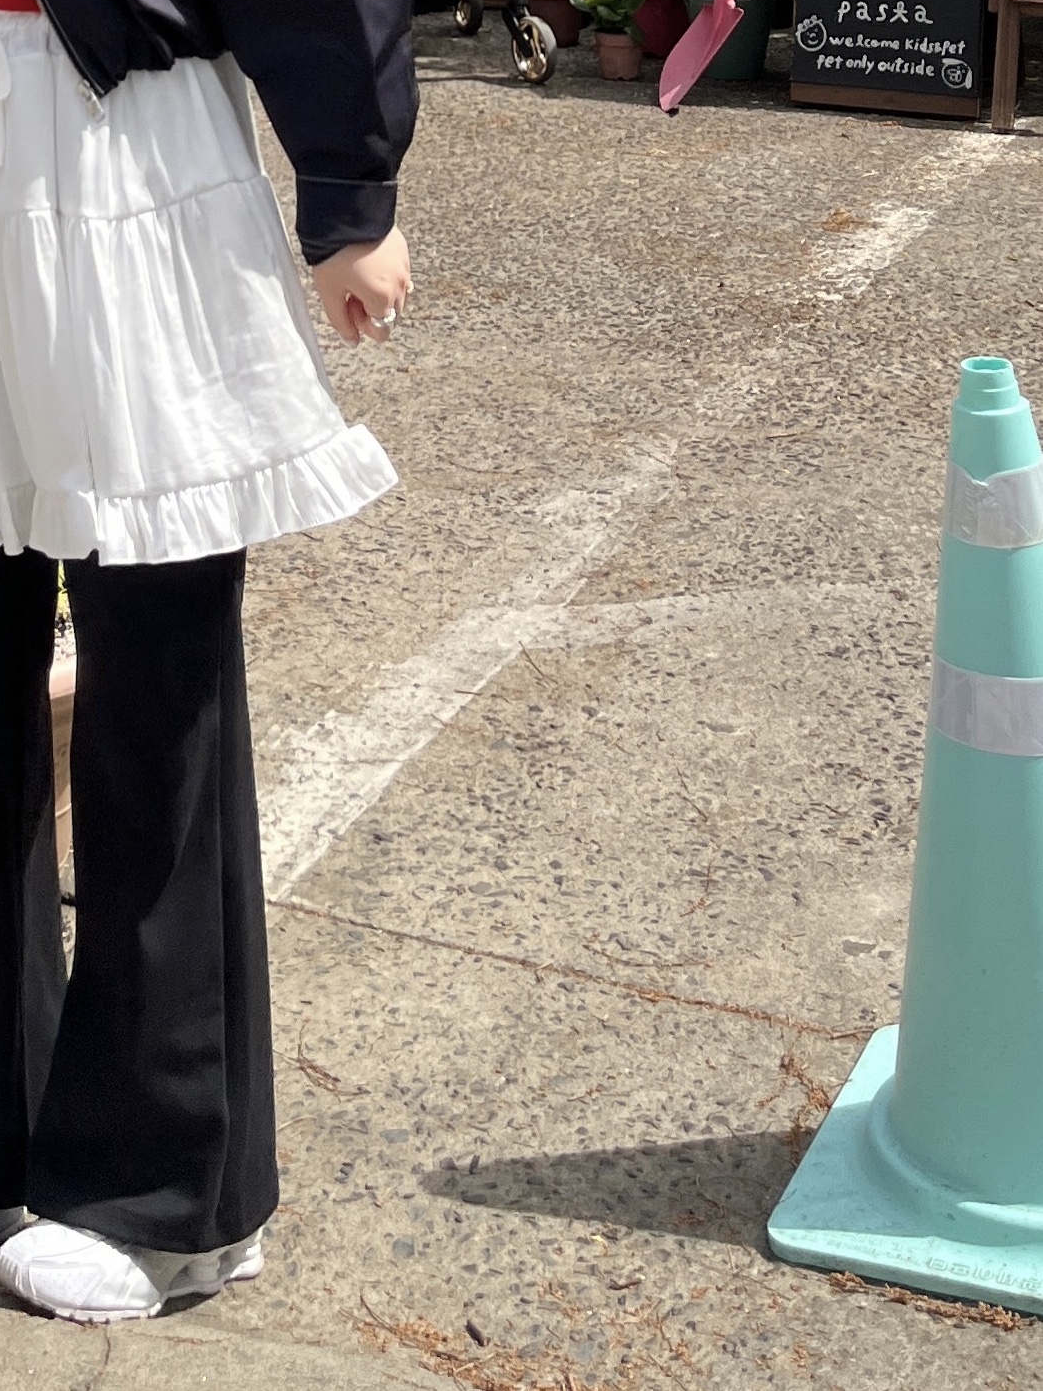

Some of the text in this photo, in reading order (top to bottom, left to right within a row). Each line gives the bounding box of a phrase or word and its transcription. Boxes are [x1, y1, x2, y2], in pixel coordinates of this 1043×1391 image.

[837, 0, 934, 24] pasta
[829, 34, 900, 50] welcome
[845, 54, 875, 75] only
[877, 57, 935, 77] outside
